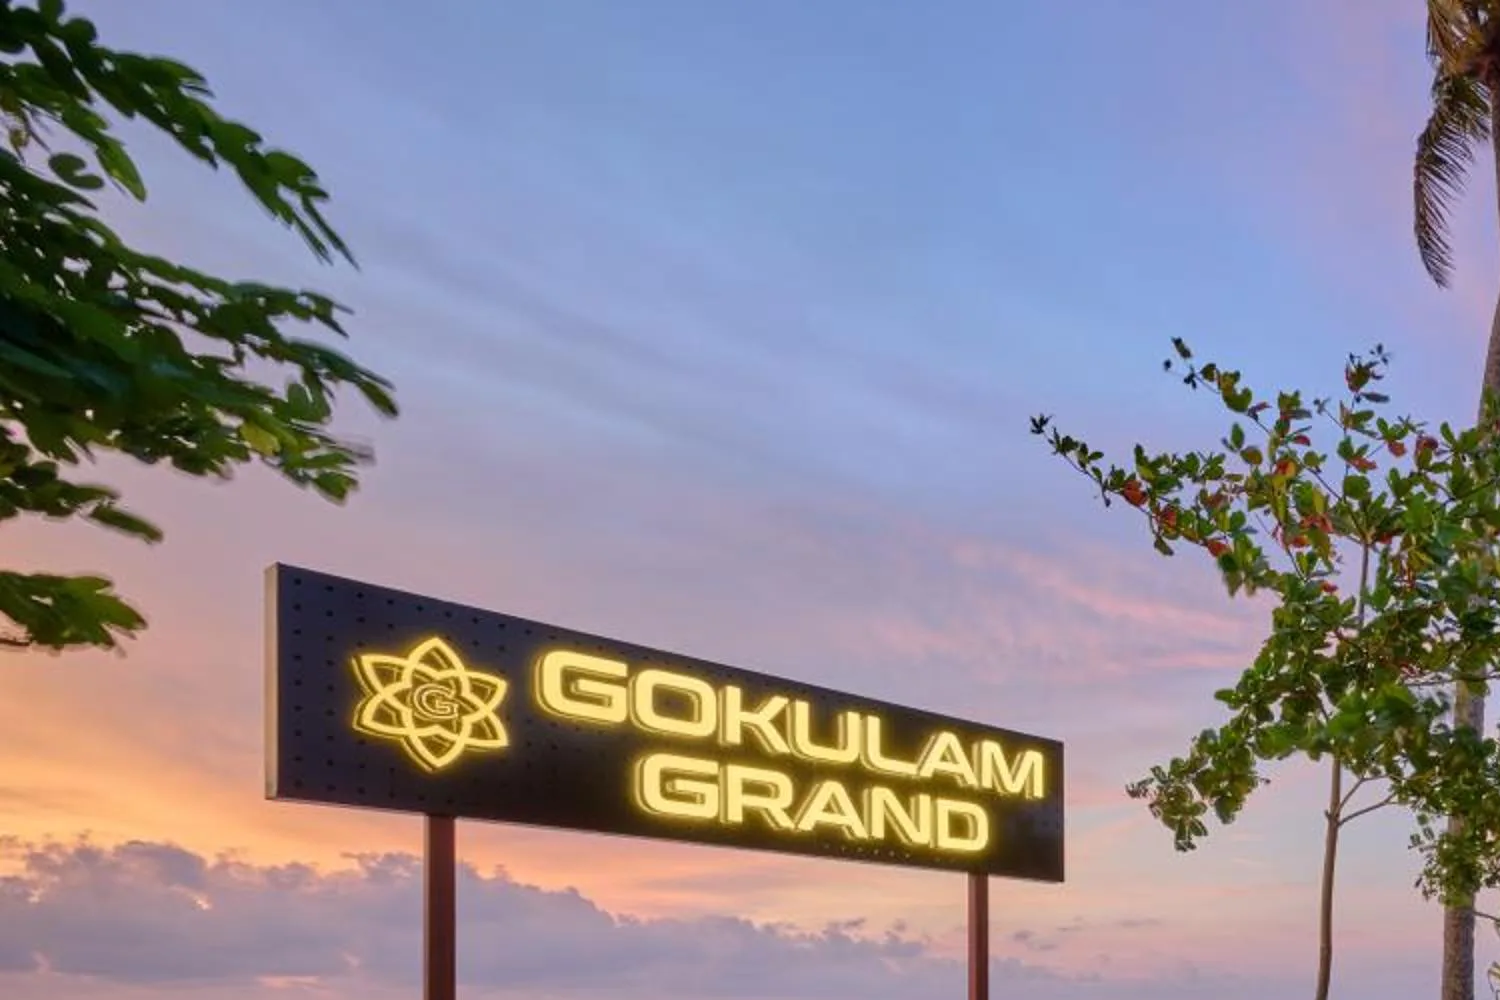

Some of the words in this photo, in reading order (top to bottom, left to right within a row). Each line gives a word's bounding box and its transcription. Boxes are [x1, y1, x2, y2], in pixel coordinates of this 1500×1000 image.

[412, 683, 458, 720] G
[536, 650, 1044, 798] GOKULAM
[636, 753, 989, 851] GRAND
